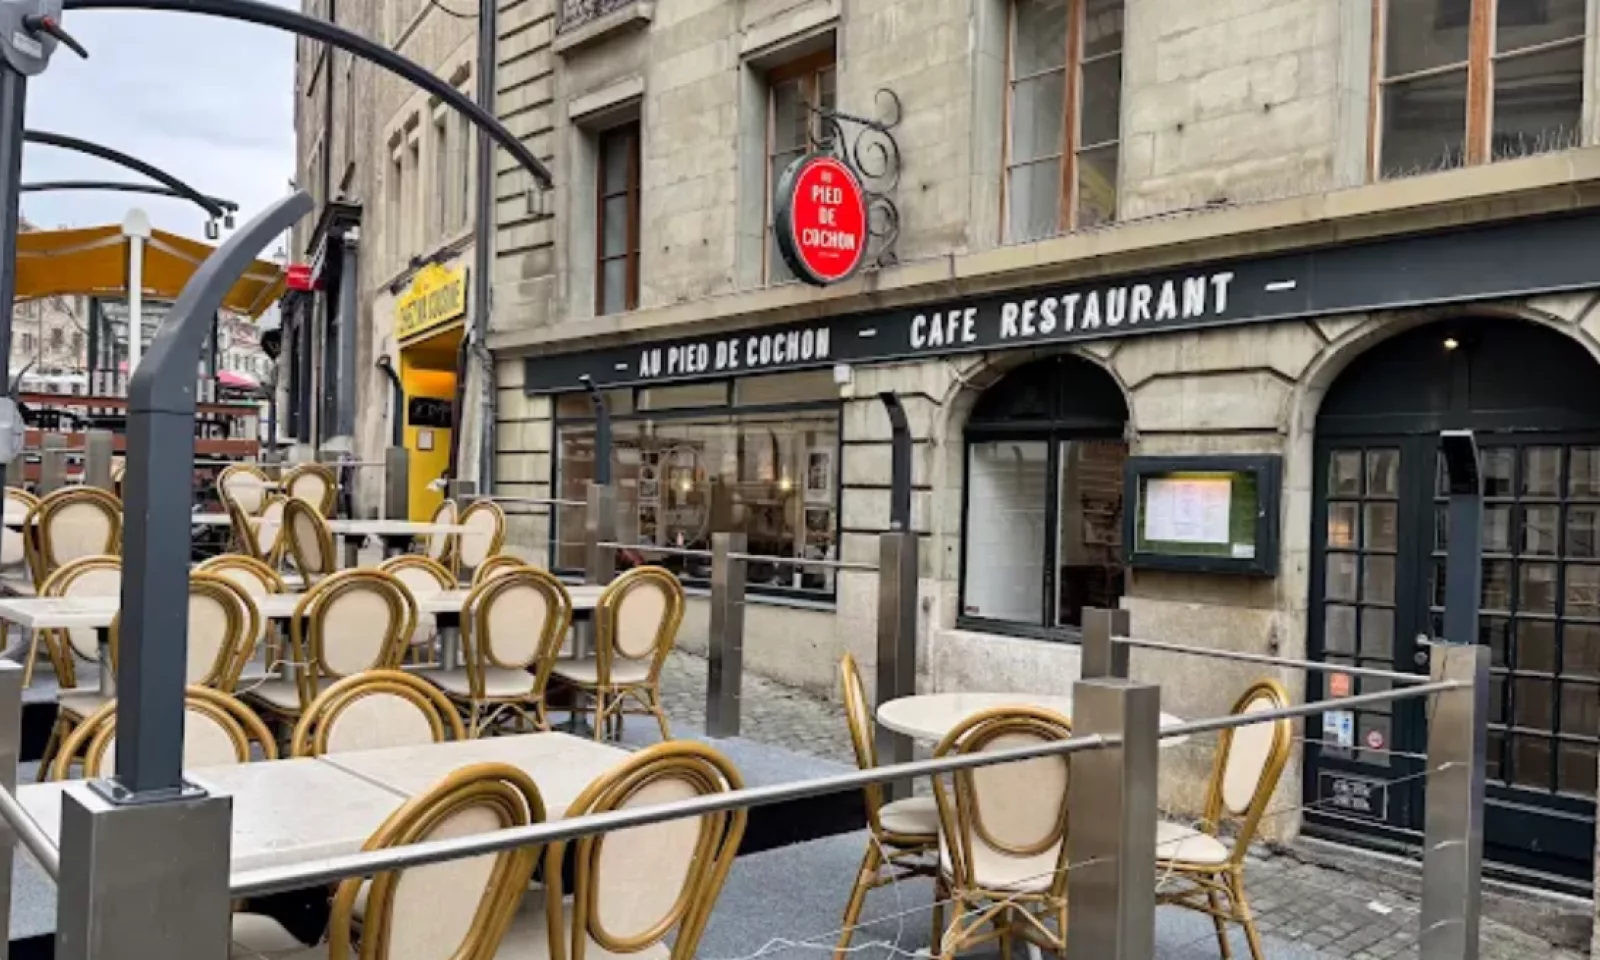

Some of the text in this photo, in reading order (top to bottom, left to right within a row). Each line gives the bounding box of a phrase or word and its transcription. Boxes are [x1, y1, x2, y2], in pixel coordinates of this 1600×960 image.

[811, 184, 843, 205] PIED
[818, 206, 837, 227] DE
[802, 227, 856, 250] COCHON
[639, 271, 1234, 377] AU PIED DE COCHON CAFE RESTAURANT
